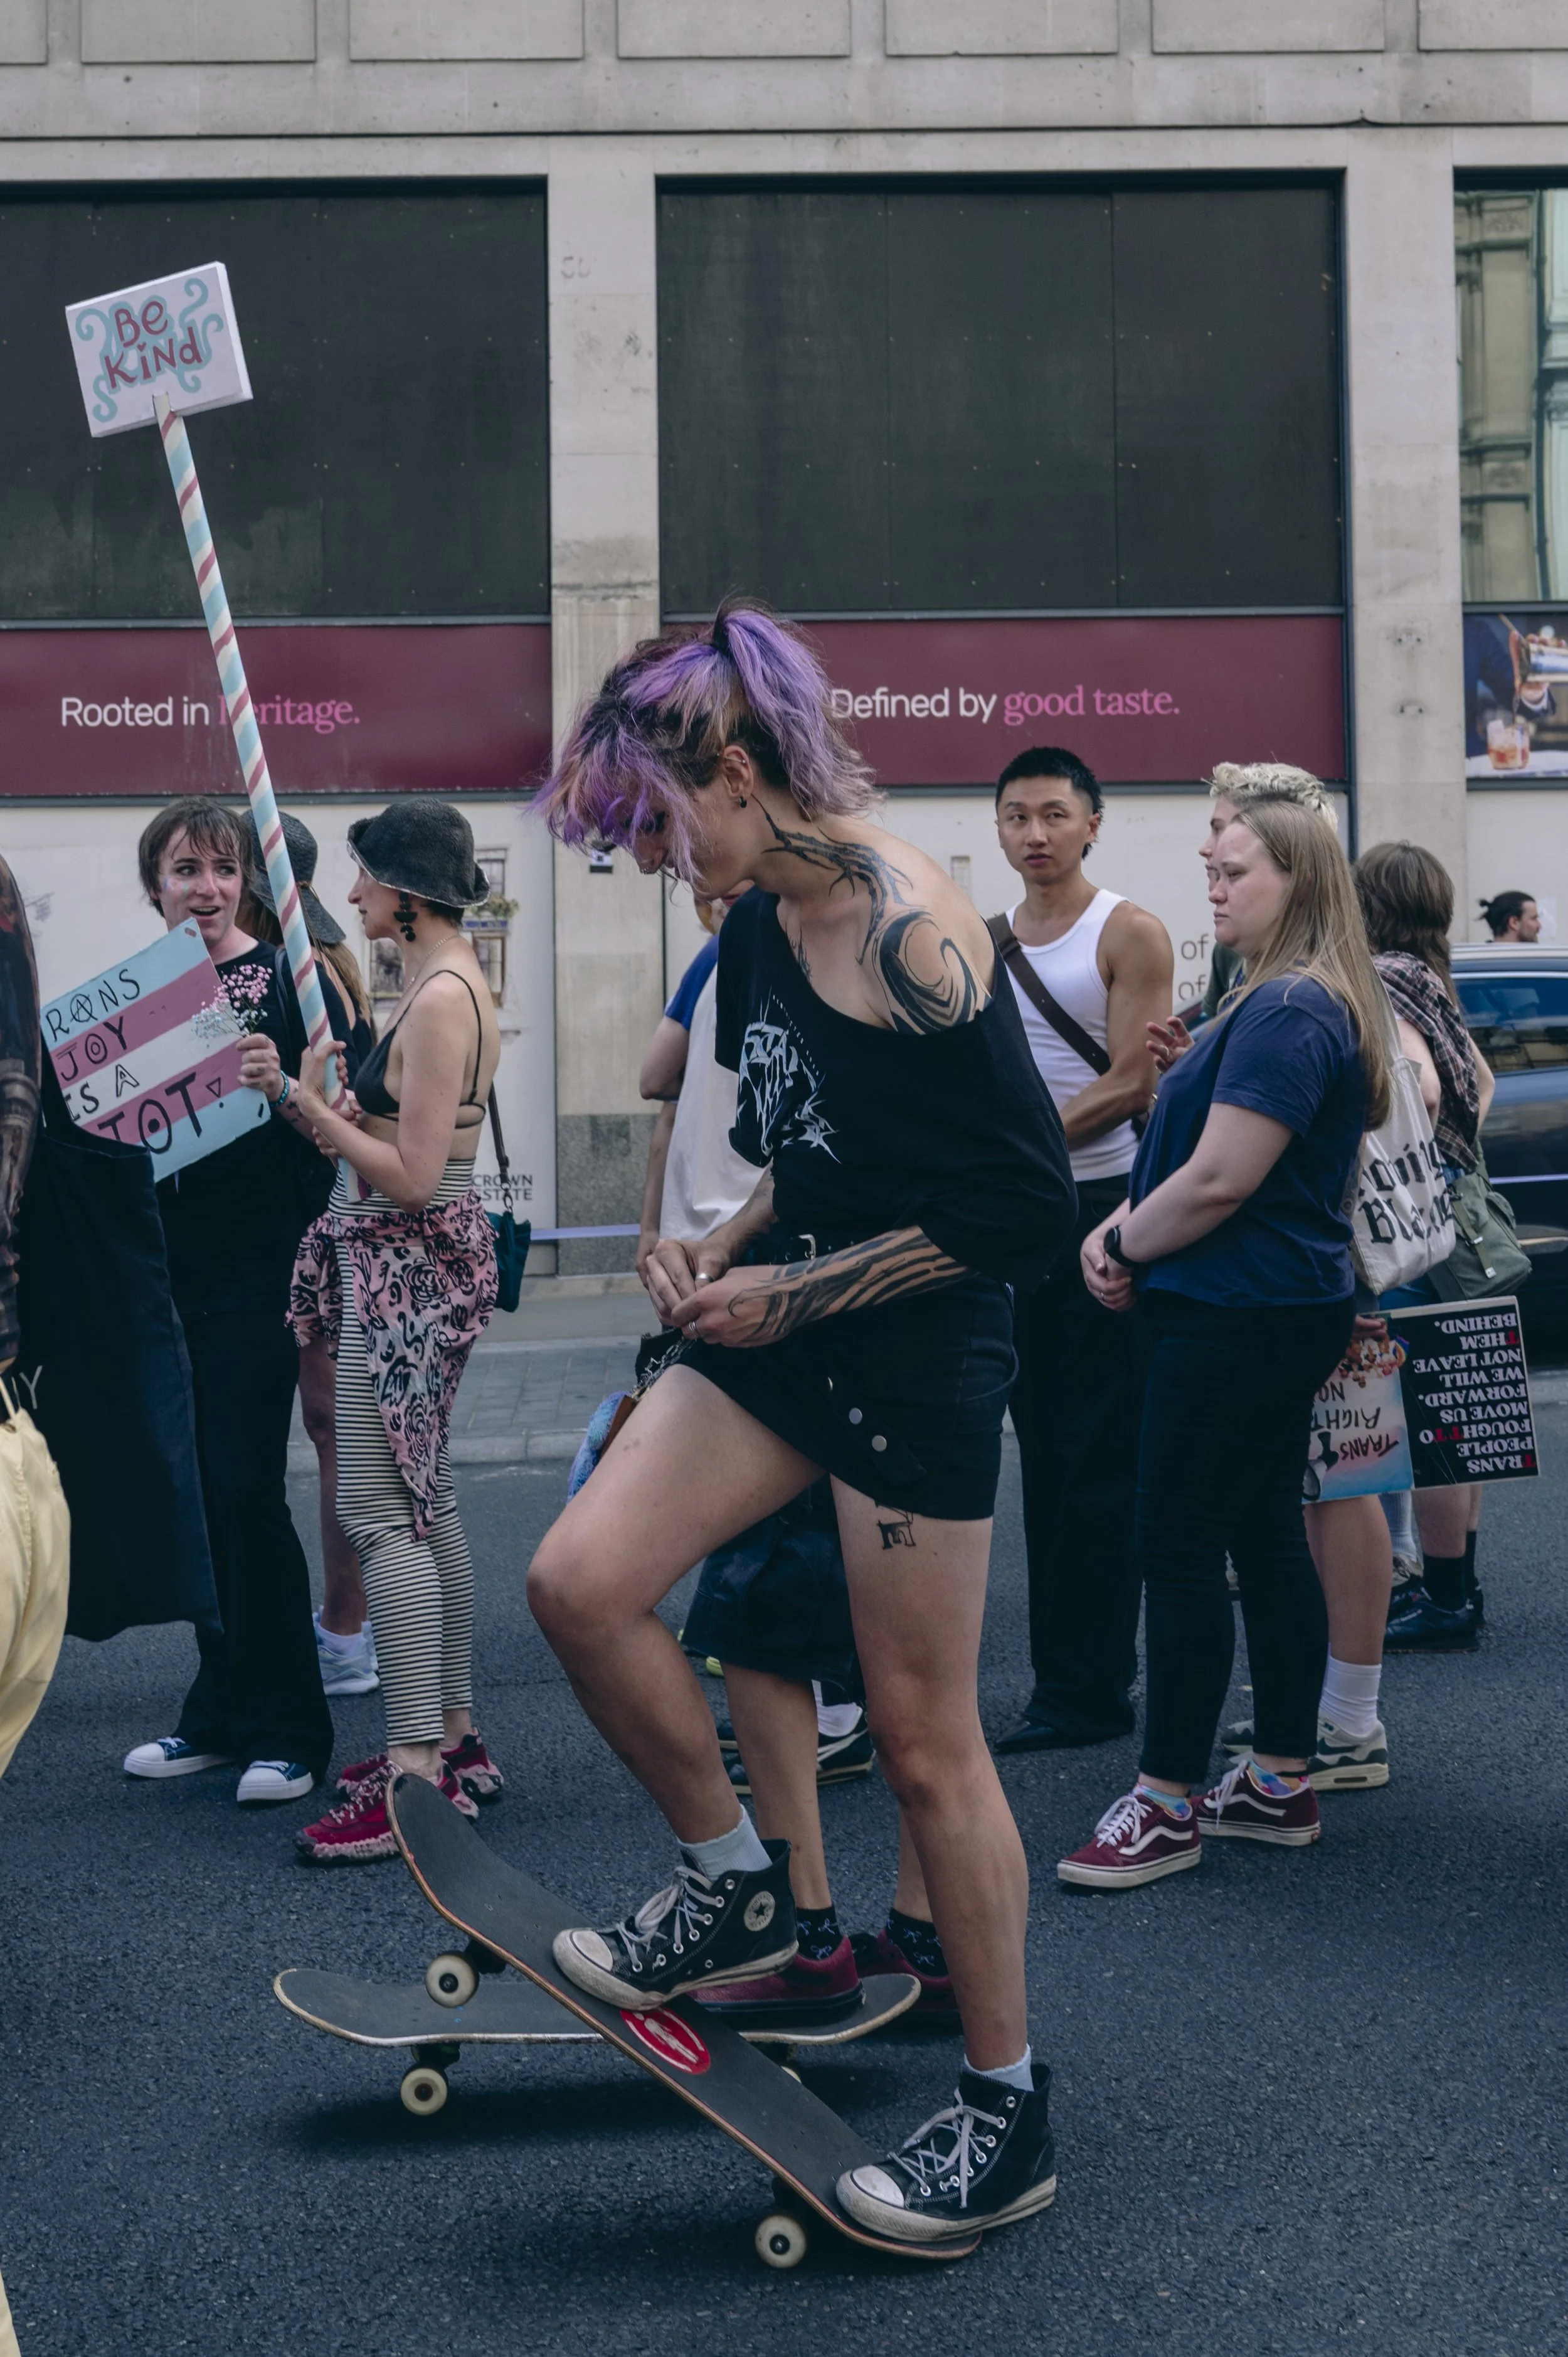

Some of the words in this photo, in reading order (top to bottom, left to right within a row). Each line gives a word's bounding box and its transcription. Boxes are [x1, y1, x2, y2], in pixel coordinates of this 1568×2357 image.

[62, 697, 172, 726] Rooted
[183, 696, 209, 725] in
[831, 687, 949, 718] Defined
[959, 688, 997, 724] by
[1004, 685, 1085, 726] good
[1093, 689, 1180, 715] taste.
[1180, 933, 1209, 960] of
[1179, 974, 1207, 1001] of
[58, 1016, 128, 1082] JOY
[63, 1082, 100, 1122] IS
[115, 1063, 140, 1098] A
[477, 1188, 532, 1201] STTE
[1434, 1312, 1517, 1334] BEHIND.
[1459, 1331, 1520, 1350] THEM
[1413, 1353, 1479, 1373] LEAVE
[1480, 1348, 1522, 1367] NOT
[1439, 1370, 1490, 1388] WILL
[1491, 1366, 1525, 1383] WE
[1313, 1381, 1346, 1403] NO
[1417, 1383, 1527, 1407] FORWARD.
[1439, 1407, 1468, 1424] US
[1470, 1401, 1528, 1420] MOVE
[1419, 1427, 1447, 1444] TO
[1449, 1418, 1532, 1440] FOUGHT
[1340, 1433, 1399, 1460] TRANS
[1456, 1436, 1534, 1457] PEOPLE
[1466, 1454, 1537, 1474] TRANS
